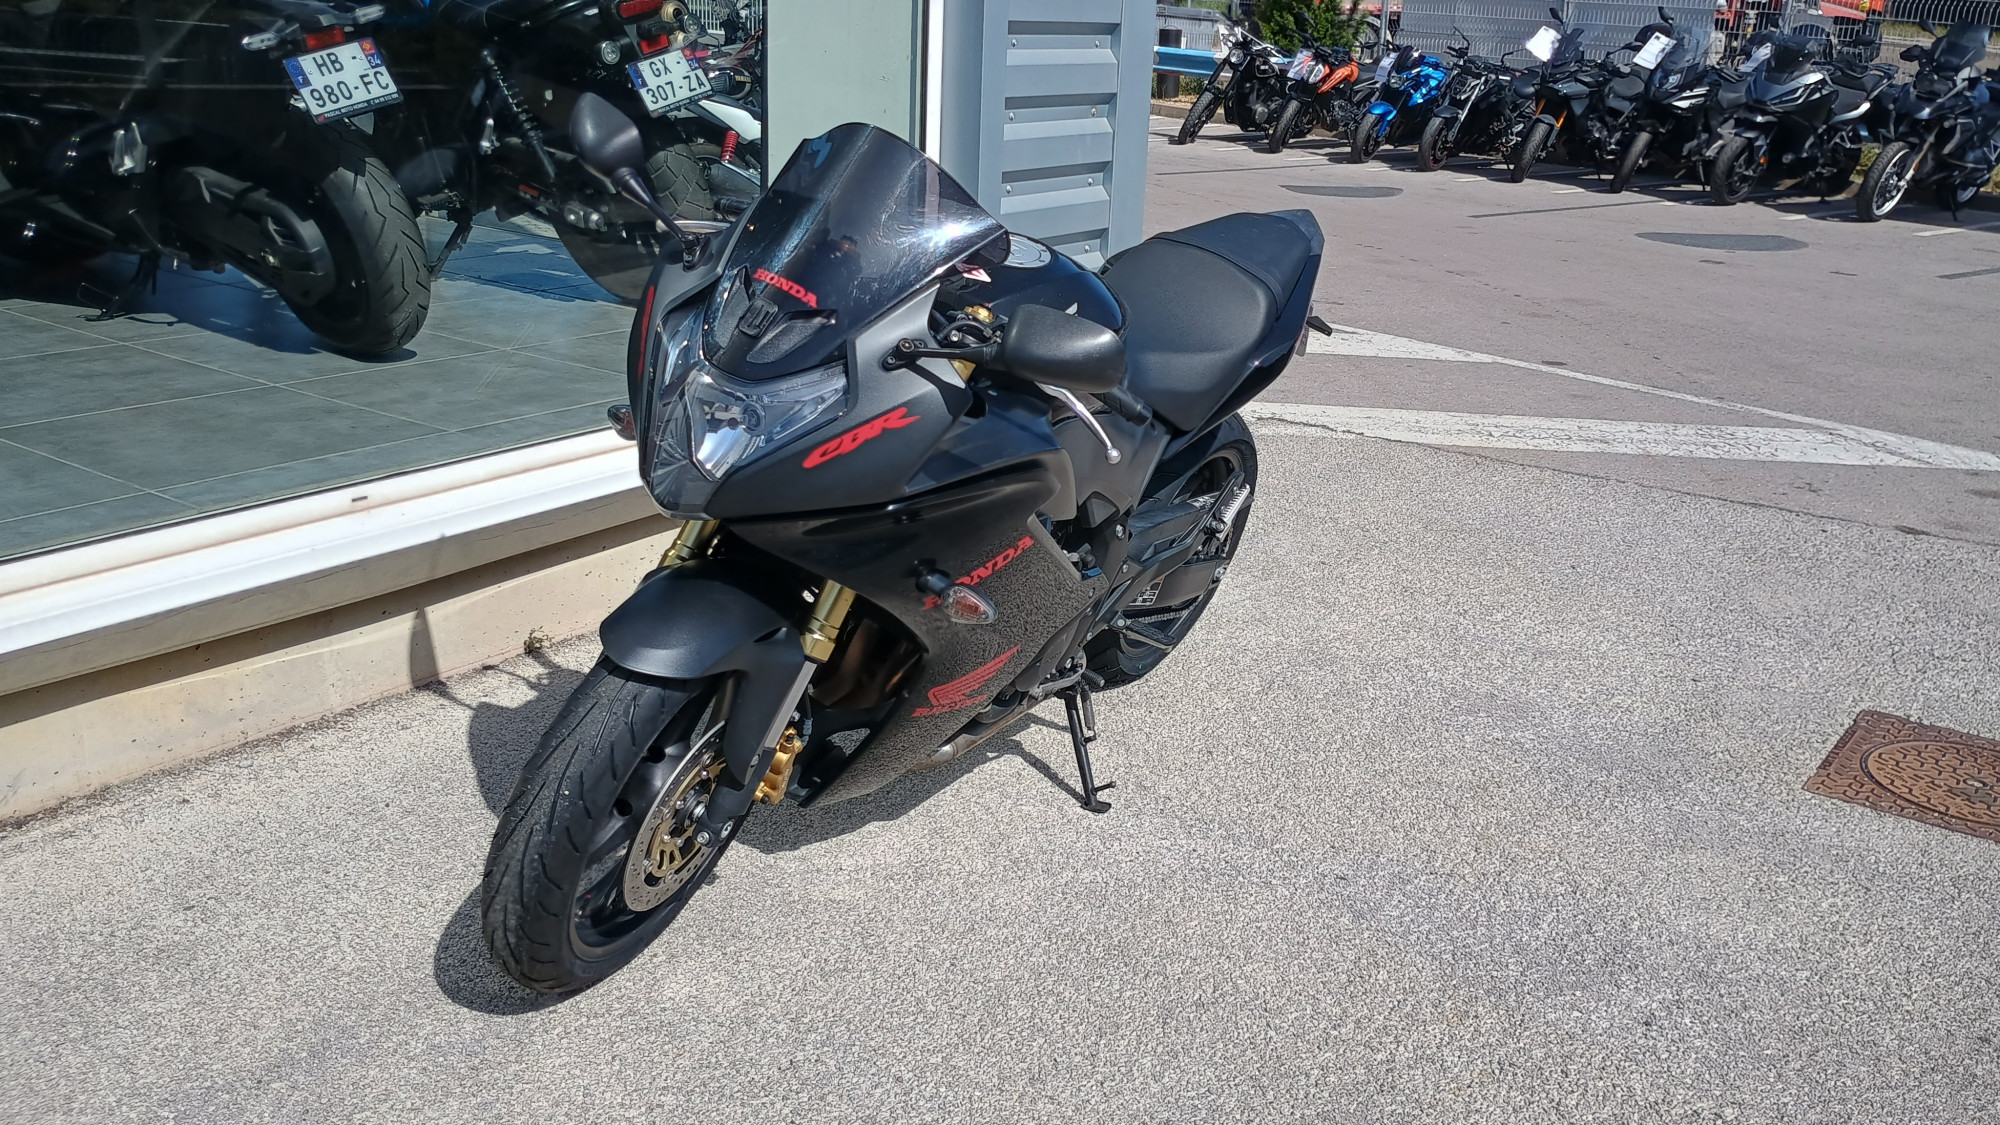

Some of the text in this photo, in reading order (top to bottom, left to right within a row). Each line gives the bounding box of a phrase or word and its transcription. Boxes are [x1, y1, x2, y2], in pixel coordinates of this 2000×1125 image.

[312, 52, 344, 76] HB
[367, 55, 381, 66] 34
[649, 57, 672, 78] GX
[688, 59, 699, 69] 34
[309, 70, 390, 109] 980-FC
[646, 72, 707, 105] 307-ZA
[753, 268, 818, 309] HONDA
[802, 407, 921, 469] CBR
